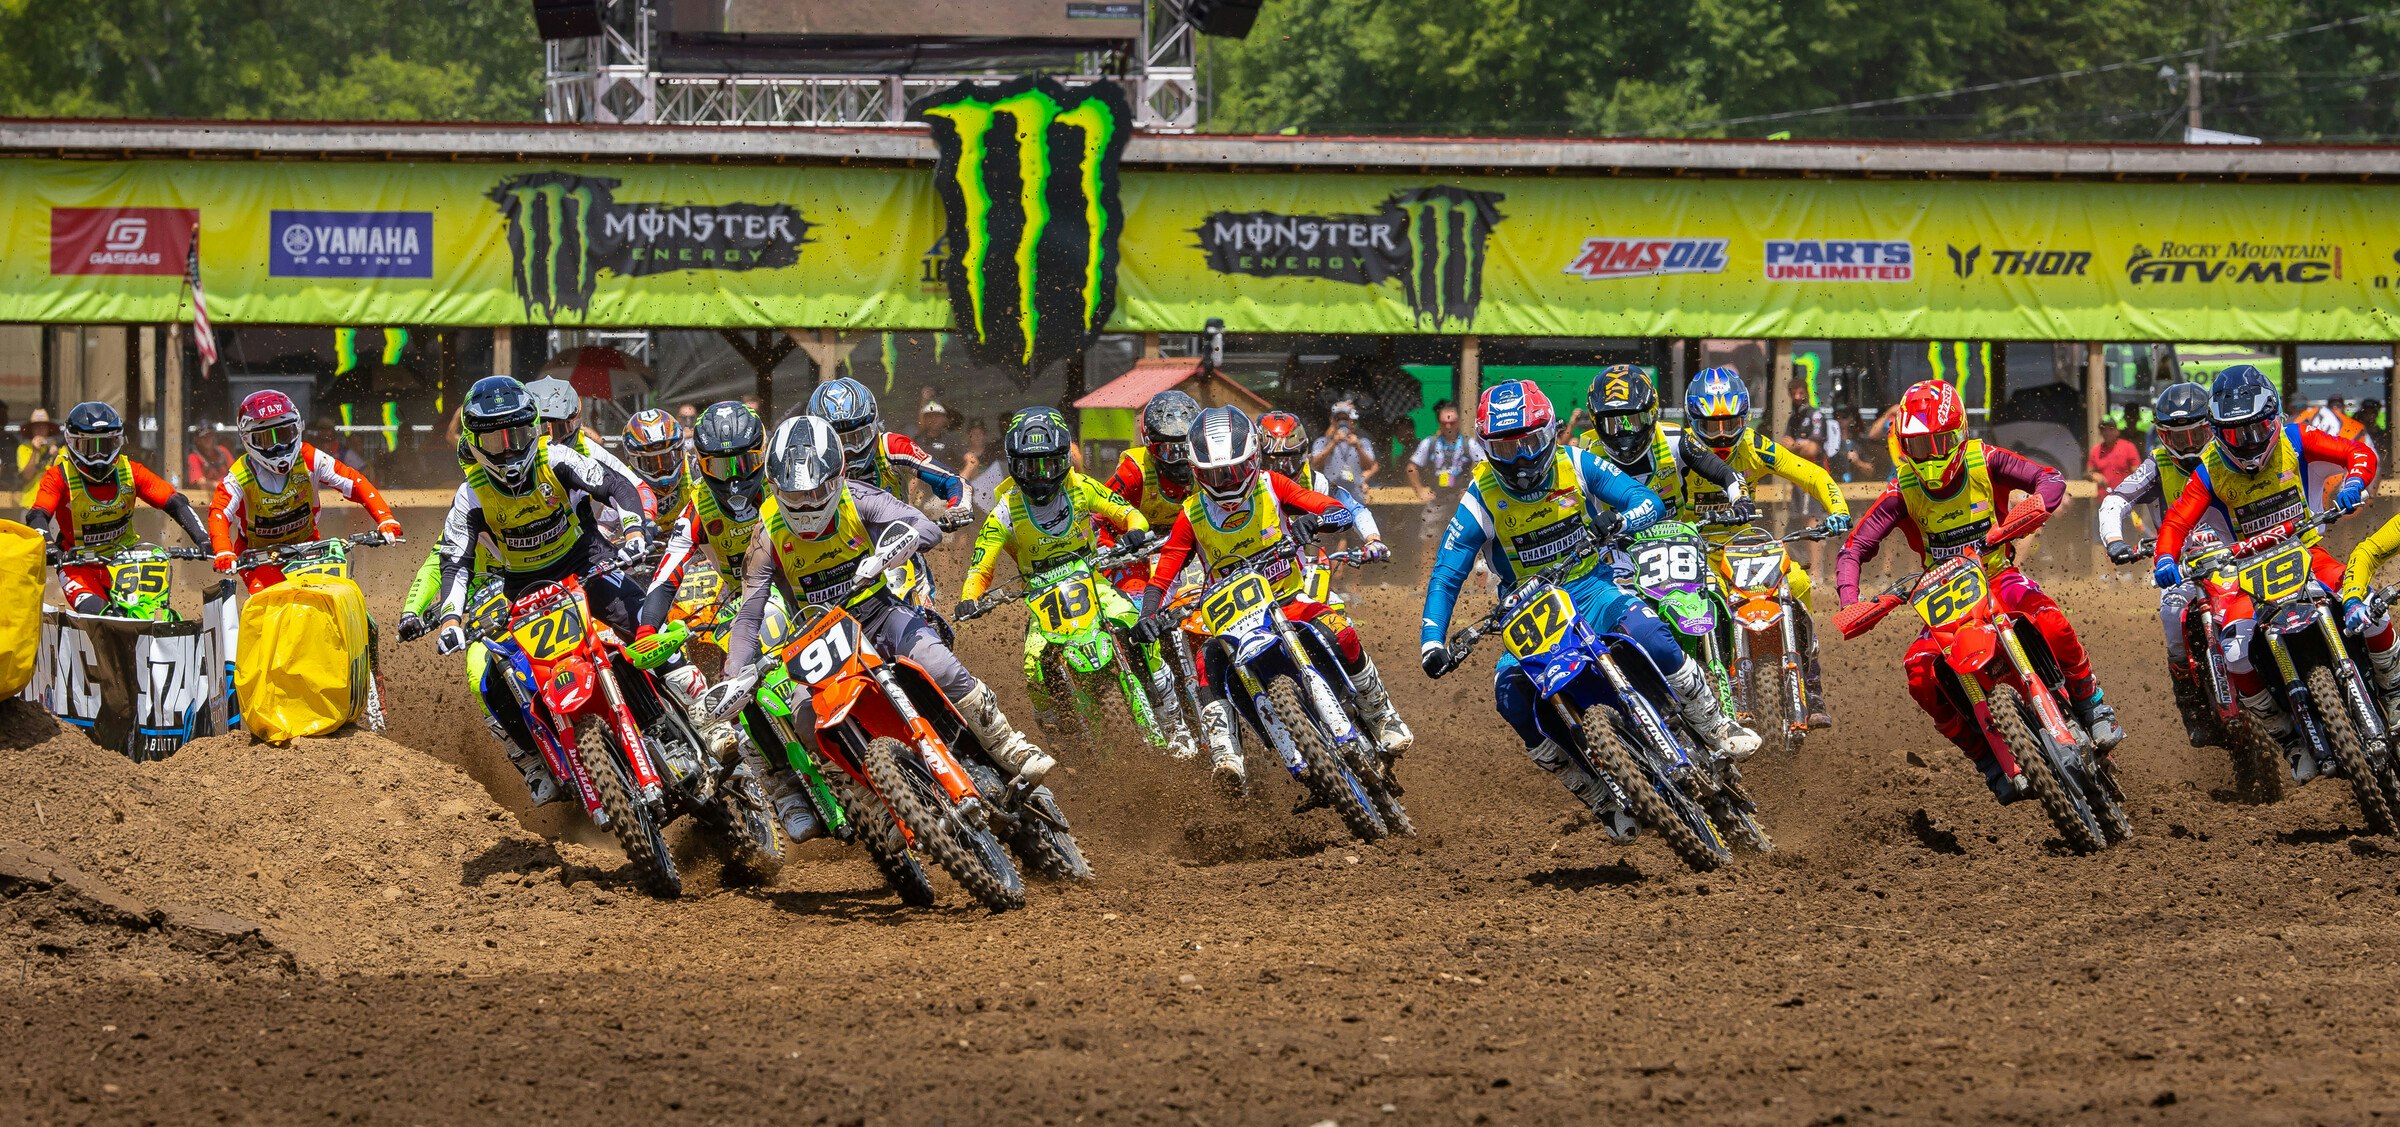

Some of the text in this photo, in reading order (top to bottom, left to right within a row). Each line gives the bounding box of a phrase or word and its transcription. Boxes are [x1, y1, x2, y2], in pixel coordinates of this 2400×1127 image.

[313, 226, 420, 255] YAMAHA
[604, 207, 796, 244] MONSTER
[1213, 216, 1396, 250] MONSTER
[89, 252, 161, 265] GASGAS
[293, 256, 413, 265] RACING
[631, 247, 764, 263] ENERGY
[1239, 255, 1366, 270] ENERGY
[1575, 240, 1729, 276] AMSOIL
[1766, 242, 1911, 264] PARTS
[1991, 250, 2093, 276] THOR
[2158, 241, 2333, 259] ROCKY MOUNTAIN
[1766, 265, 1912, 280] UNLIMITED
[1495, 410, 1519, 420] YAMAHA
[2350, 452, 2369, 475] FLY
[262, 487, 298, 505] Kawasaki
[2243, 503, 2303, 534] CHAMPIONSHIP
[882, 534, 914, 567] ACERBIS
[1521, 527, 1588, 561] CHAMPIONSHIP
[115, 565, 168, 599] 65
[1638, 545, 1698, 588] 38
[1732, 555, 1781, 591] 17
[2245, 551, 2305, 600] 19
[1039, 583, 1091, 631] 18
[1207, 577, 1266, 632] 50
[1926, 570, 1983, 628] 63
[530, 608, 584, 660] 24
[1509, 600, 1564, 657] 92
[641, 639, 680, 663] ACERBIS
[800, 621, 853, 685] 91
[714, 688, 746, 720] ACERBIS
[2349, 679, 2374, 729] DUNLOP
[622, 722, 651, 777] DUNLOP
[1632, 705, 1675, 760] DUNLOP
[568, 748, 598, 803] DUNLOP
